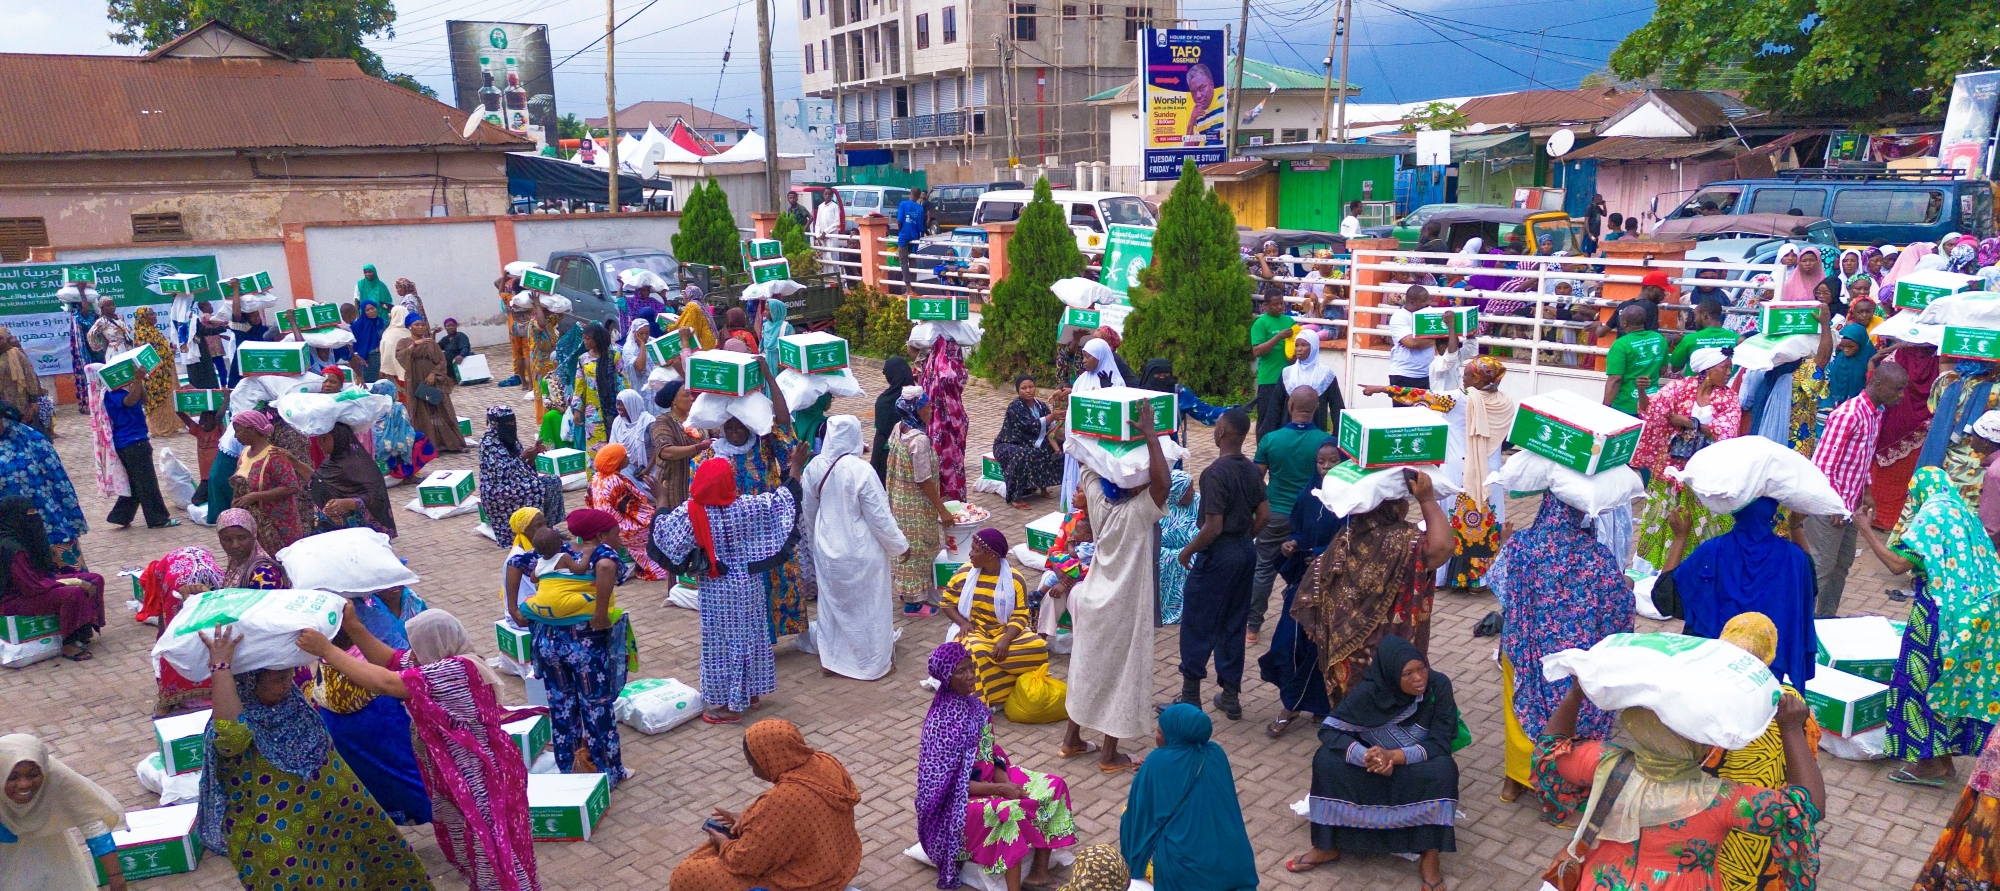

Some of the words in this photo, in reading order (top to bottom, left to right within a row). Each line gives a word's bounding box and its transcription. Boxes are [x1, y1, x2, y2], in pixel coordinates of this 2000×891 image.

[1170, 46, 1201, 57] TAFO
[1154, 96, 1187, 105] Worship
[1149, 155, 1176, 163] TUESDAY
[1150, 165, 1170, 173] FRIDAY
[96, 276, 122, 284] ABIA
[19, 333, 54, 342] جمهور
[284, 596, 308, 611] Rice
[1728, 656, 1755, 674] Rice
[1748, 666, 1772, 687] Mai
